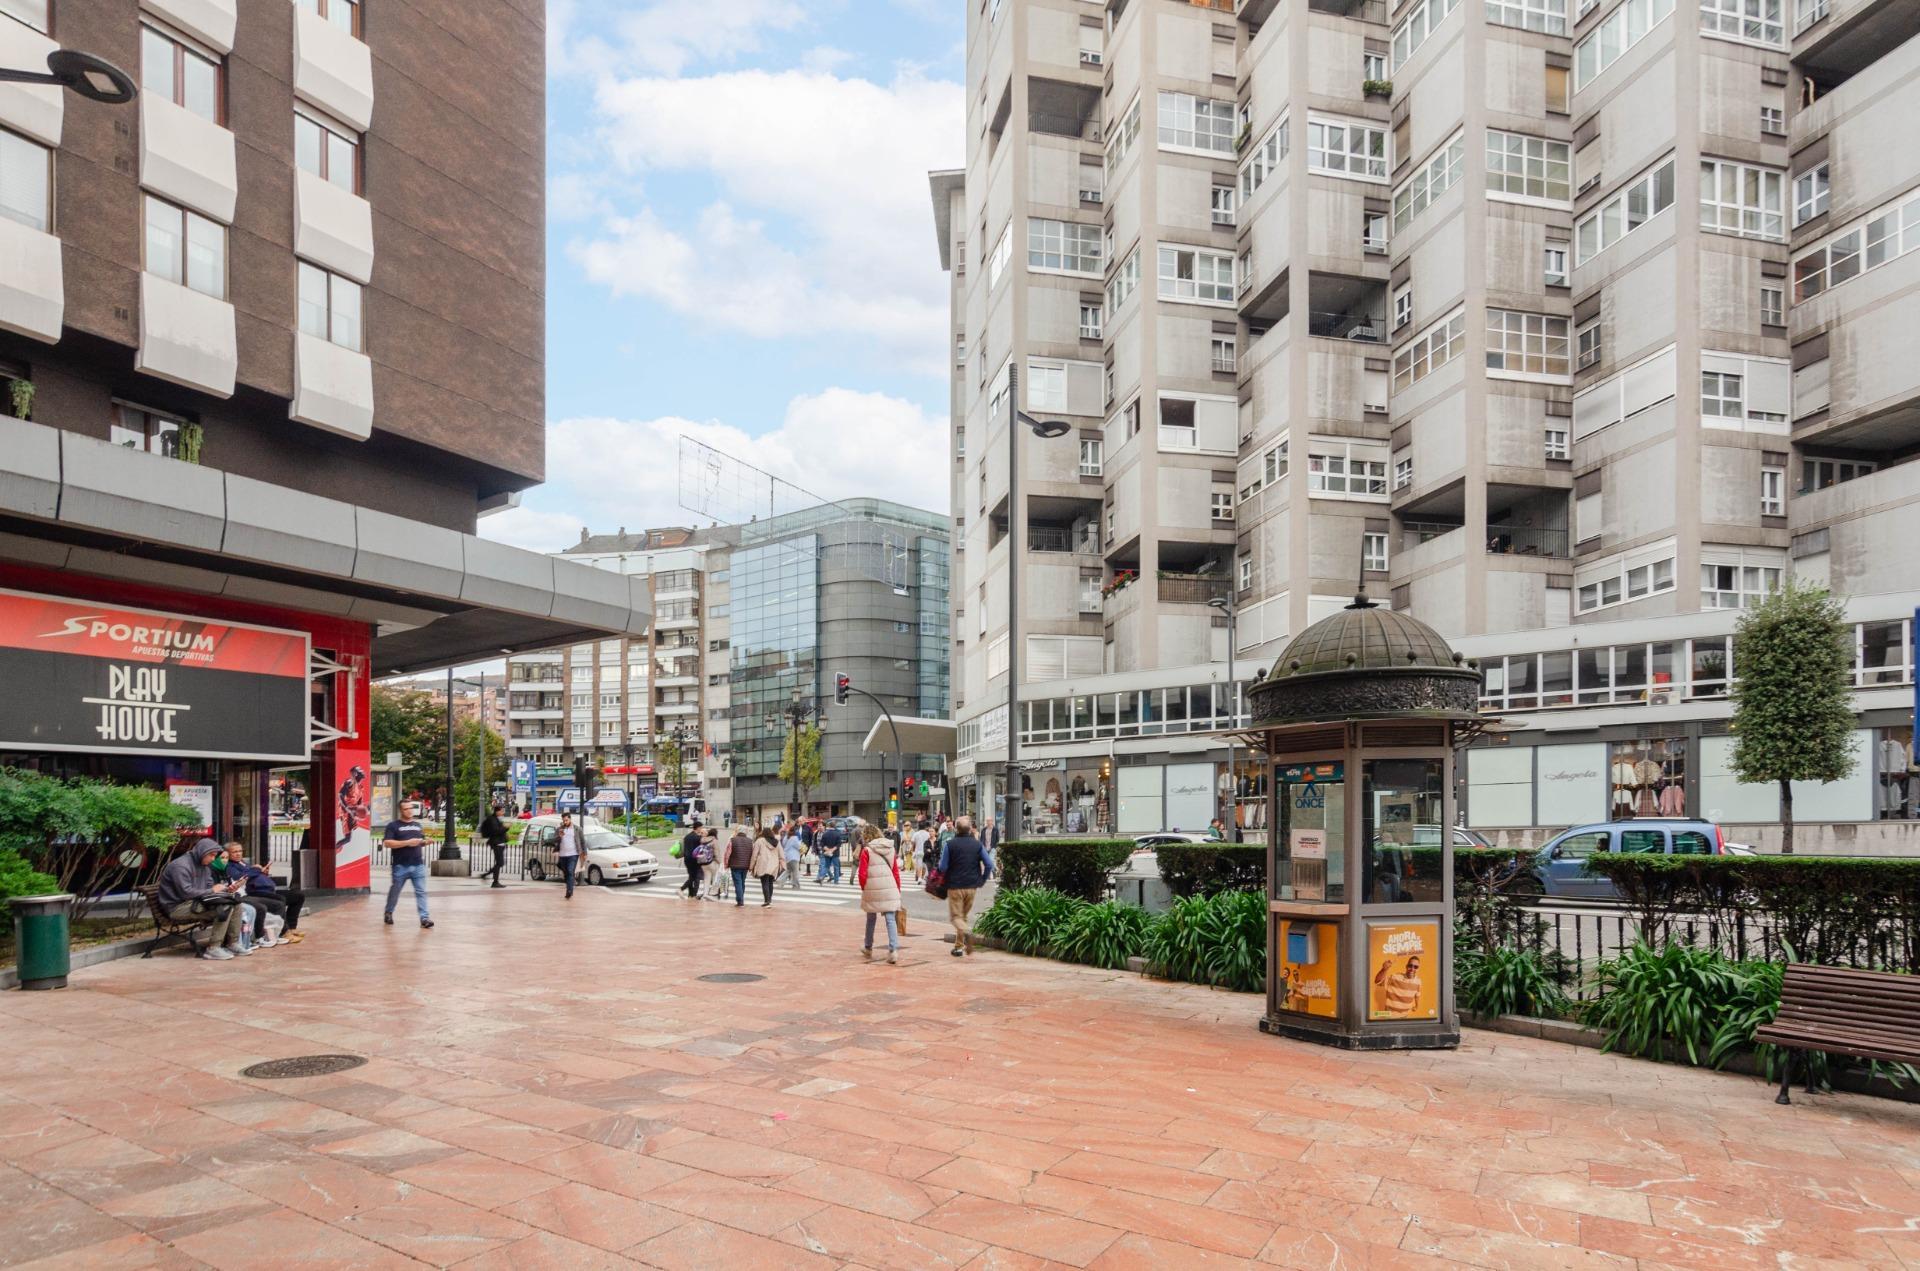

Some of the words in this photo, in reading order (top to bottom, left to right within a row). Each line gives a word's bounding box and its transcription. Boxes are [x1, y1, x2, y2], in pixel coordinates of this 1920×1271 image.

[37, 615, 214, 652] SPORTIUM
[132, 645, 170, 658] APUESTAS
[171, 650, 215, 662] DEPORTIVAS
[109, 664, 167, 703] PLAY
[95, 704, 177, 744] HOUSE
[1295, 798, 1325, 808] ONCE
